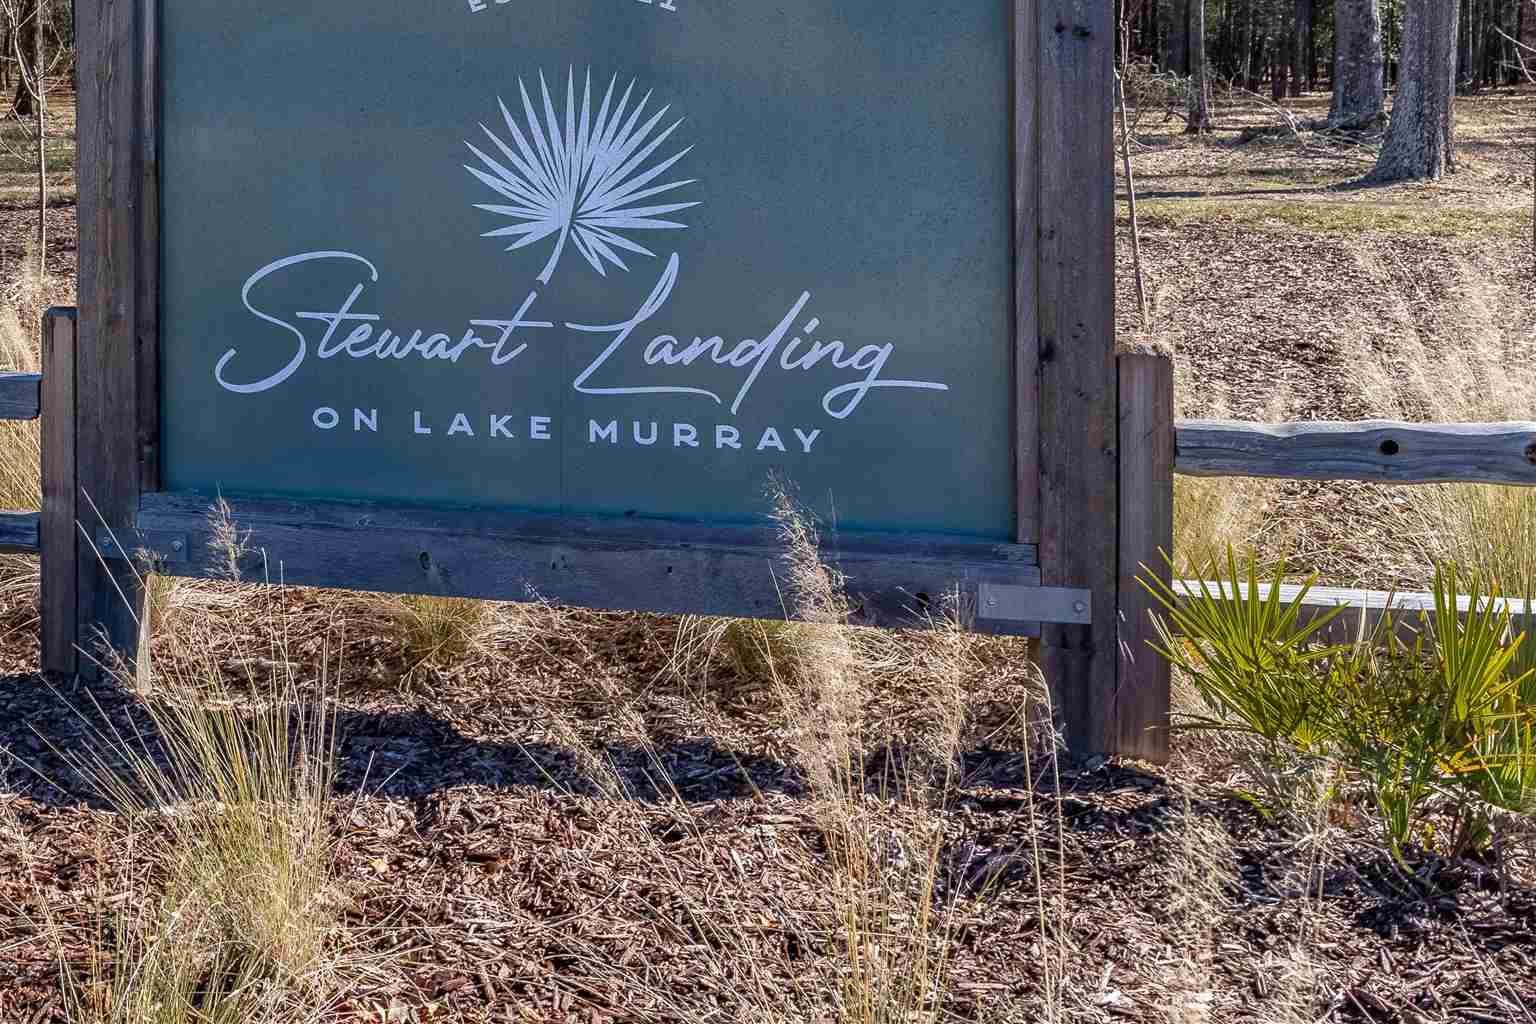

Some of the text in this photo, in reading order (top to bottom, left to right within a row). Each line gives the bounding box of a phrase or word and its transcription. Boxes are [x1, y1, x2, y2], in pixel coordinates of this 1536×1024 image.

[215, 250, 949, 420] Stewart Landing
[312, 407, 823, 453] ON LAKE MURRAY
